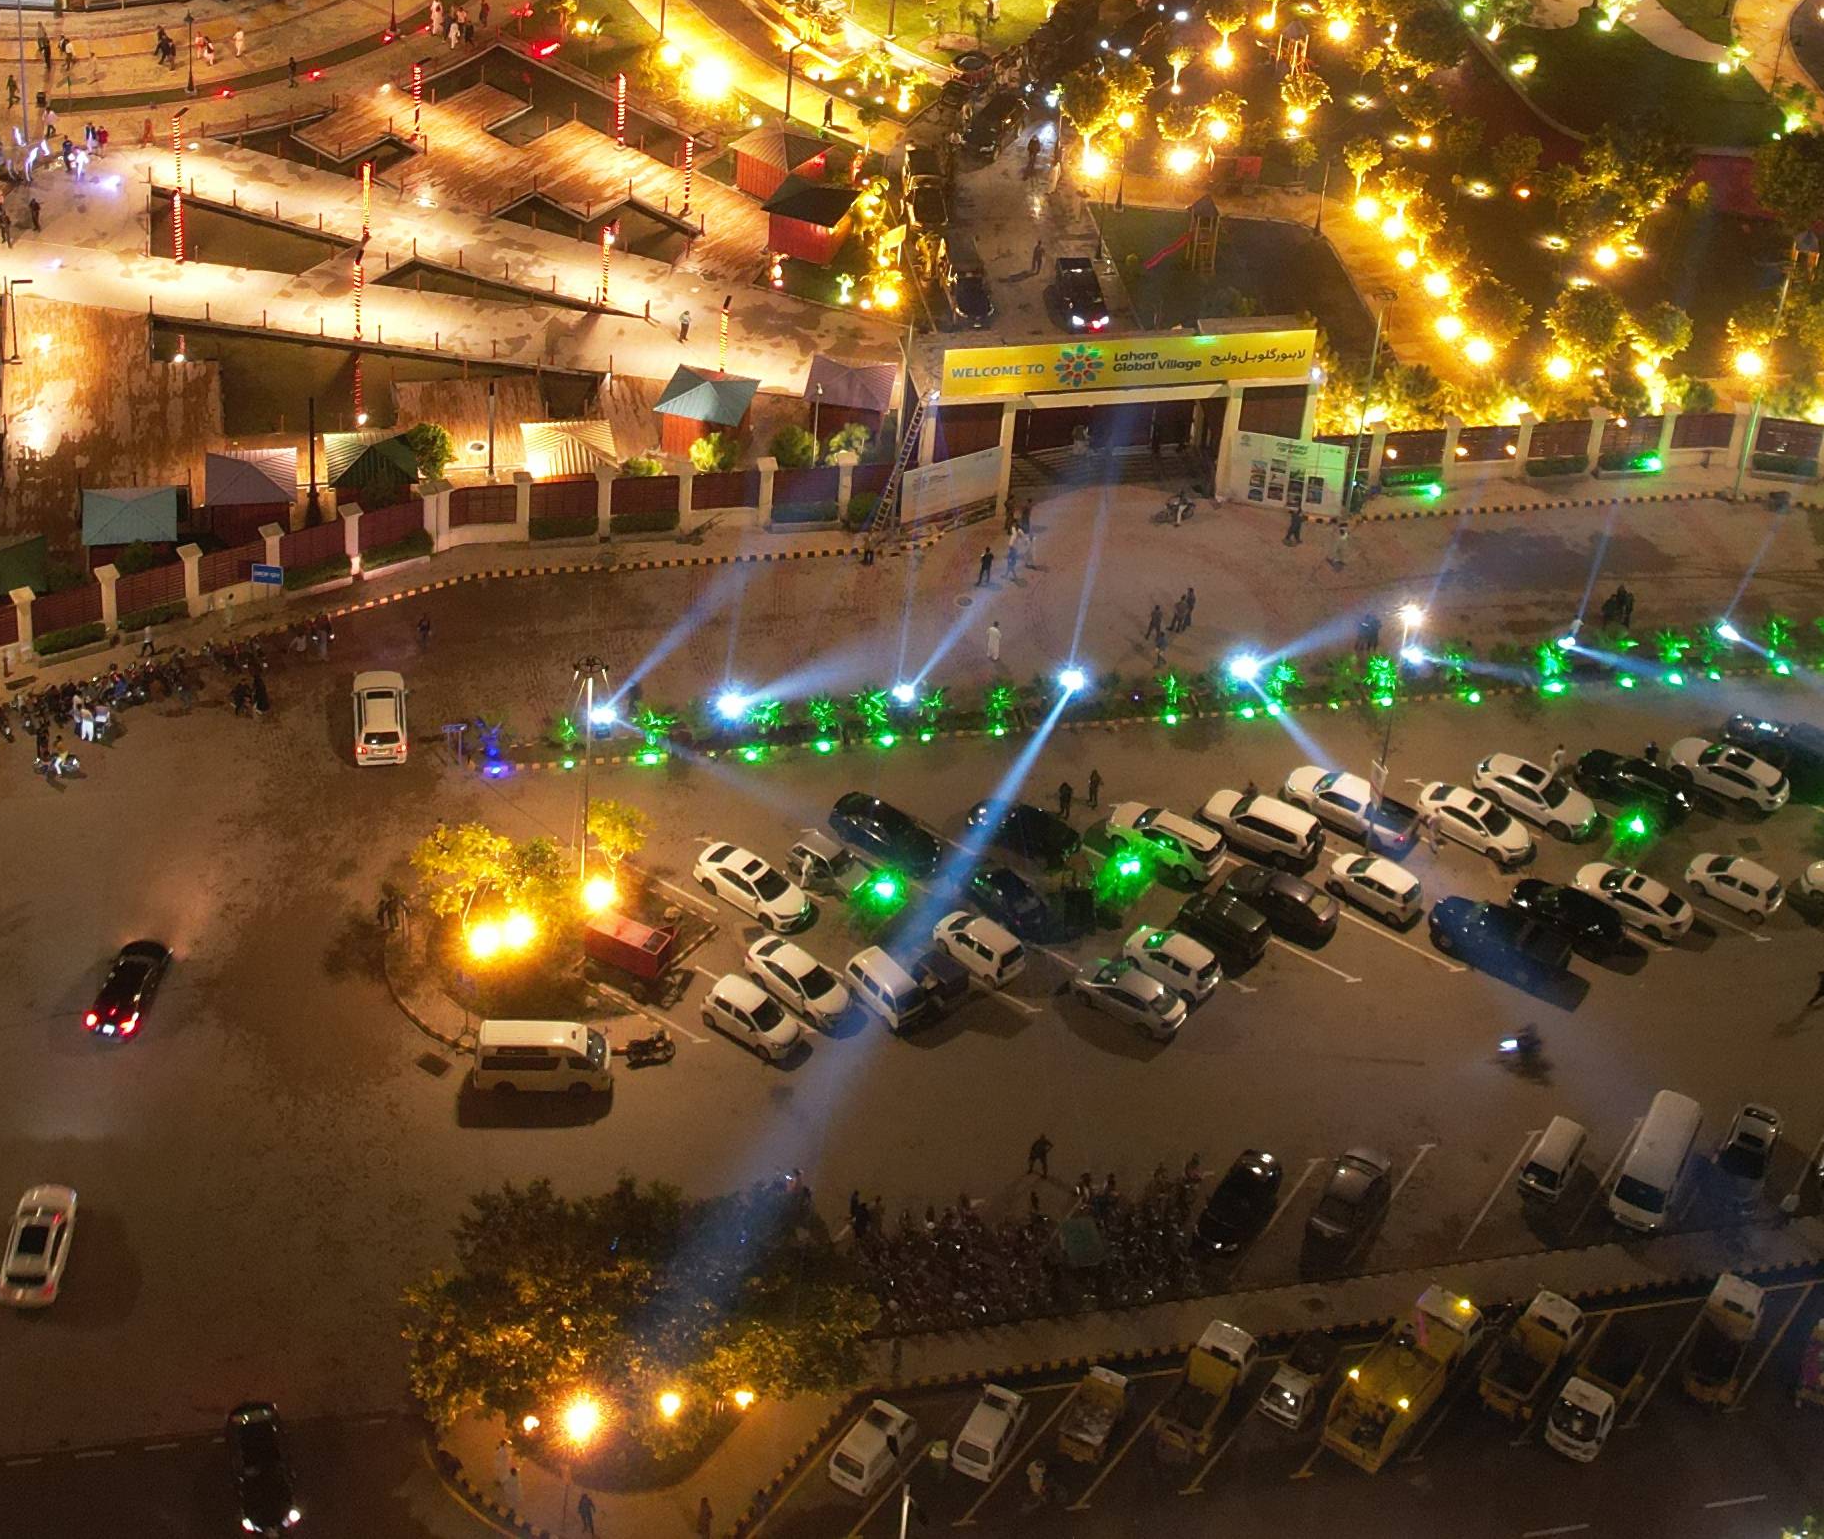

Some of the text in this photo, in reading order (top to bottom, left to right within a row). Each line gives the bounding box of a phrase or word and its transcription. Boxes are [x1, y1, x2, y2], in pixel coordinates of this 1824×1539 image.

[1114, 351, 1159, 362] Lahore
[952, 364, 1045, 378] WELCOME TO
[1113, 359, 1202, 372] Global Village
